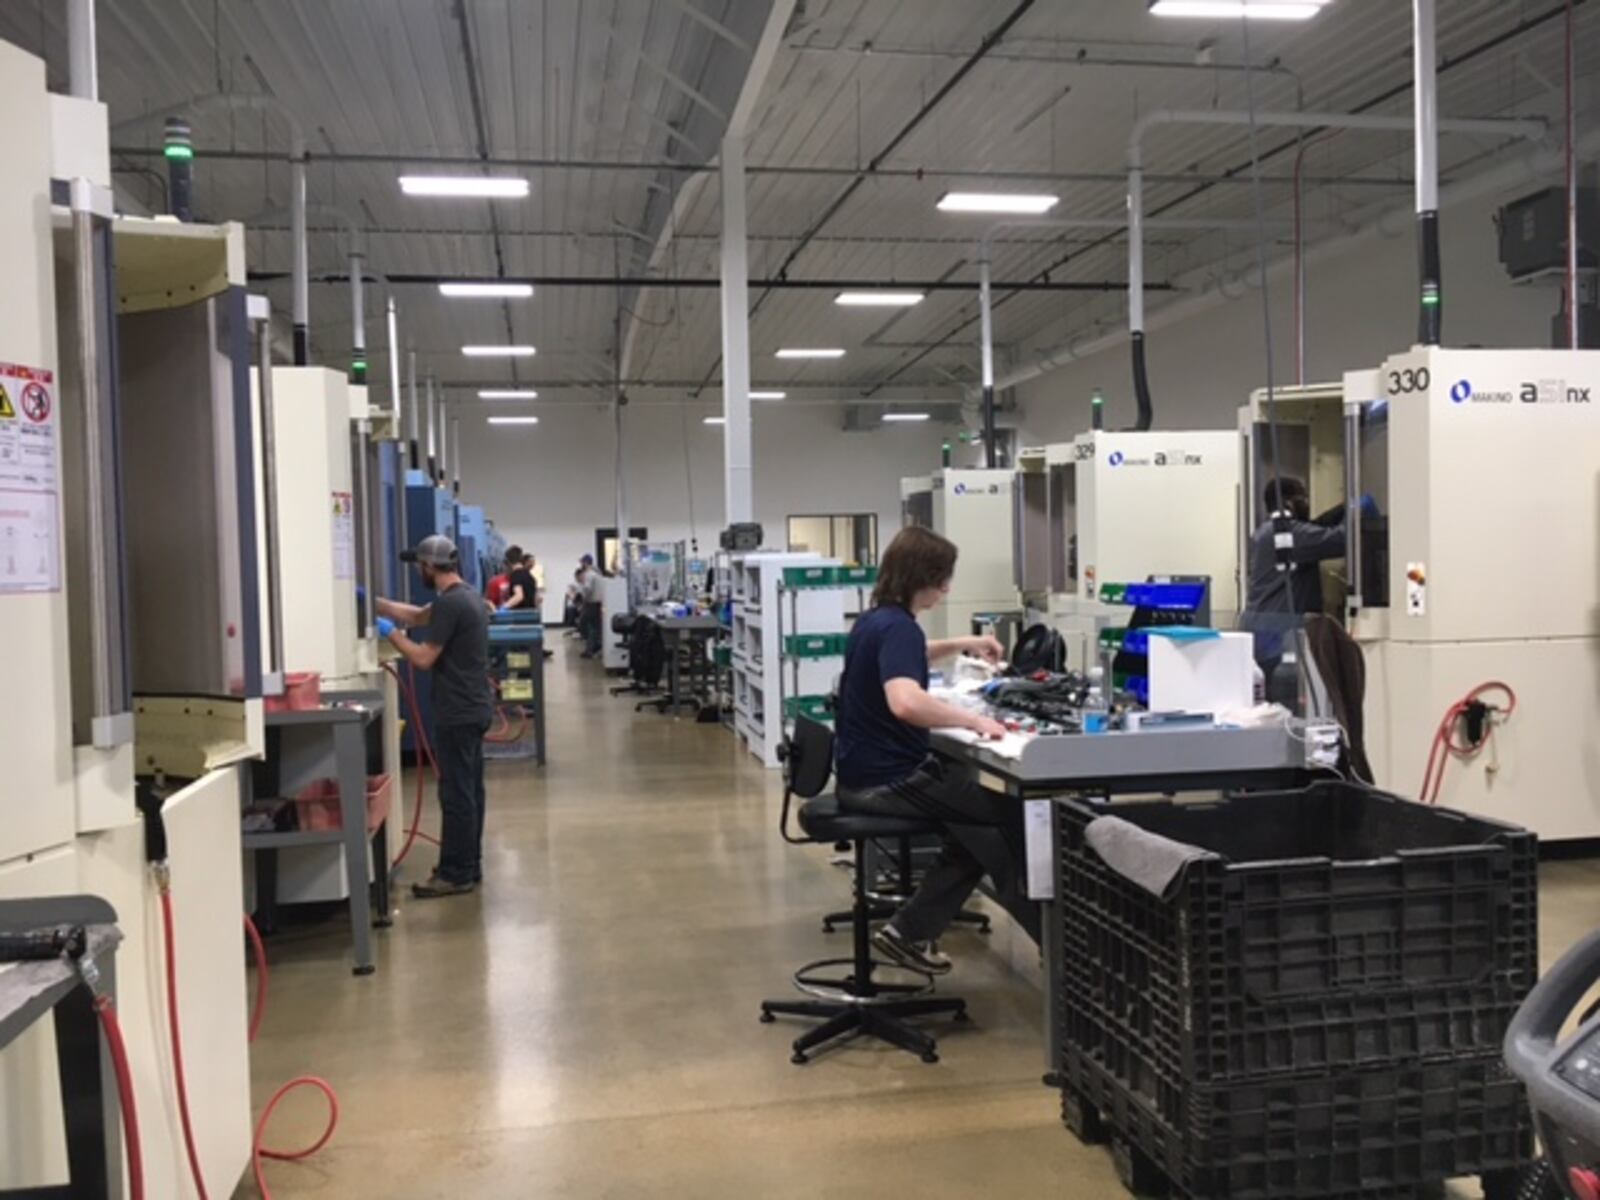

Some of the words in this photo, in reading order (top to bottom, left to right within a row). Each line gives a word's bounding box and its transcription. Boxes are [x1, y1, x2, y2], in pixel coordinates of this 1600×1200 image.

[1388, 367, 1430, 395] 330
[1471, 391, 1513, 403] MAKINO
[1075, 442, 1095, 461] 329
[1154, 449, 1203, 466] anx
